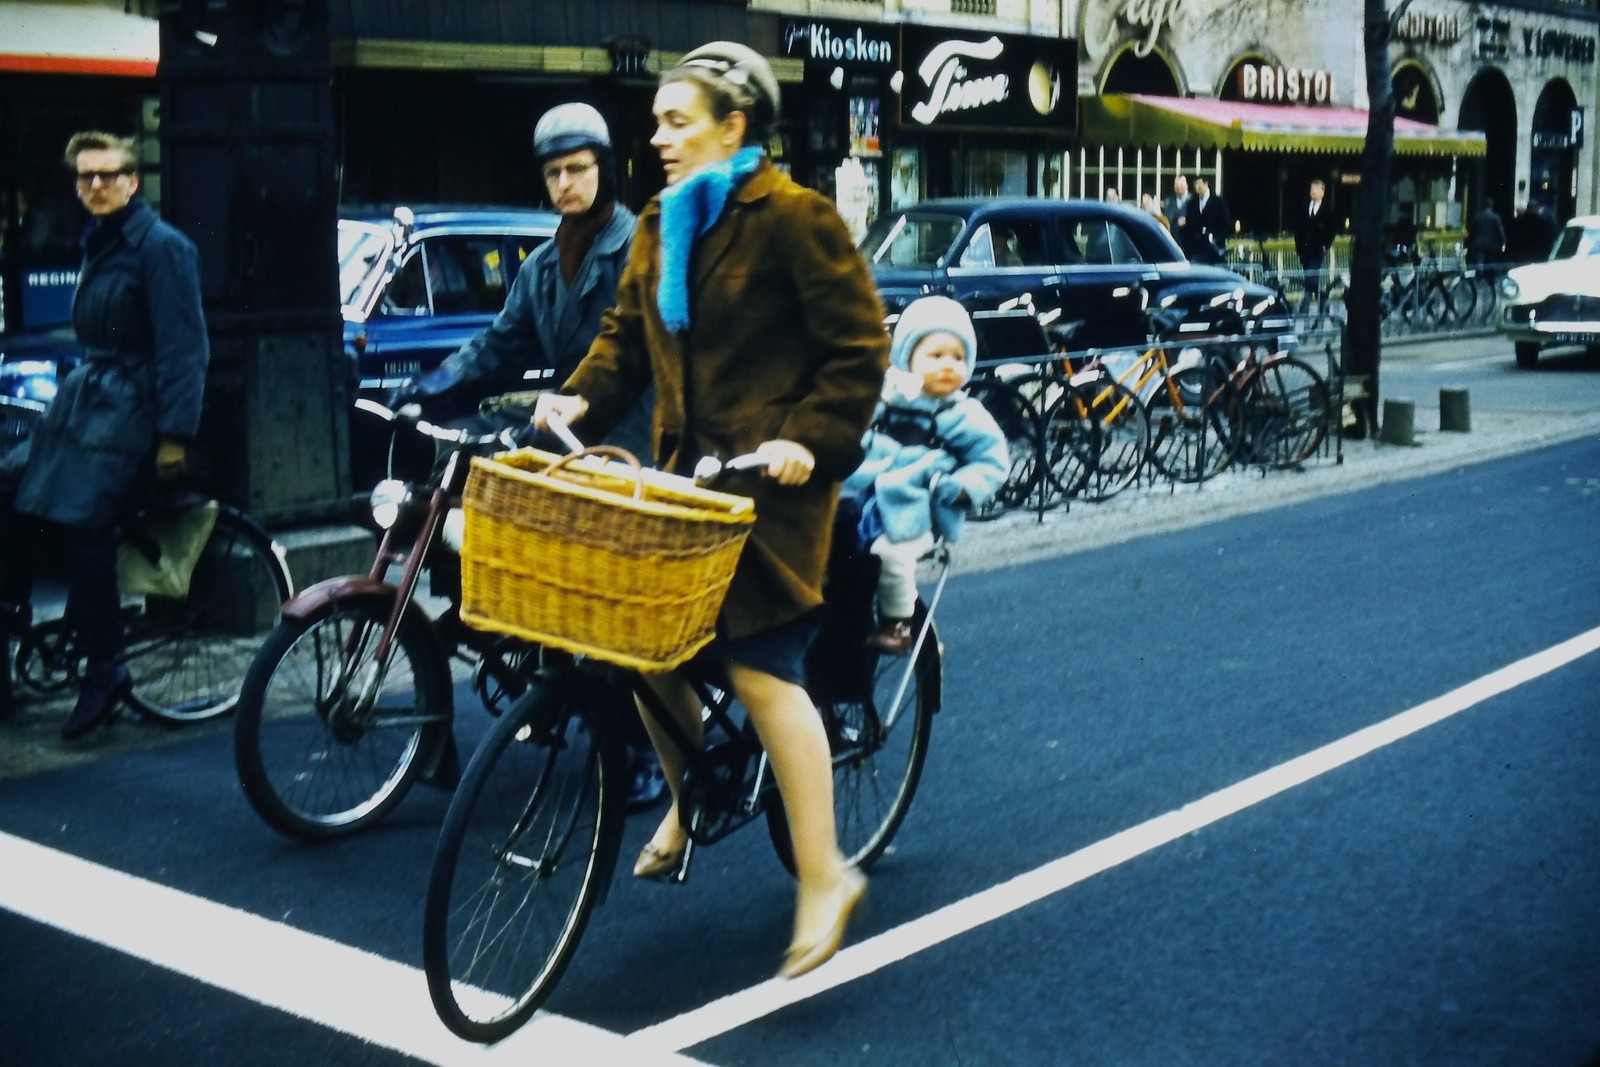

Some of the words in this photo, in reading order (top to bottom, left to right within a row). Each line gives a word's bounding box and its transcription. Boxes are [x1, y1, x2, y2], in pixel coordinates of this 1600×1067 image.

[810, 23, 892, 63] Kiosken
[1243, 64, 1340, 104] BRISTOL
[1570, 110, 1582, 144] P
